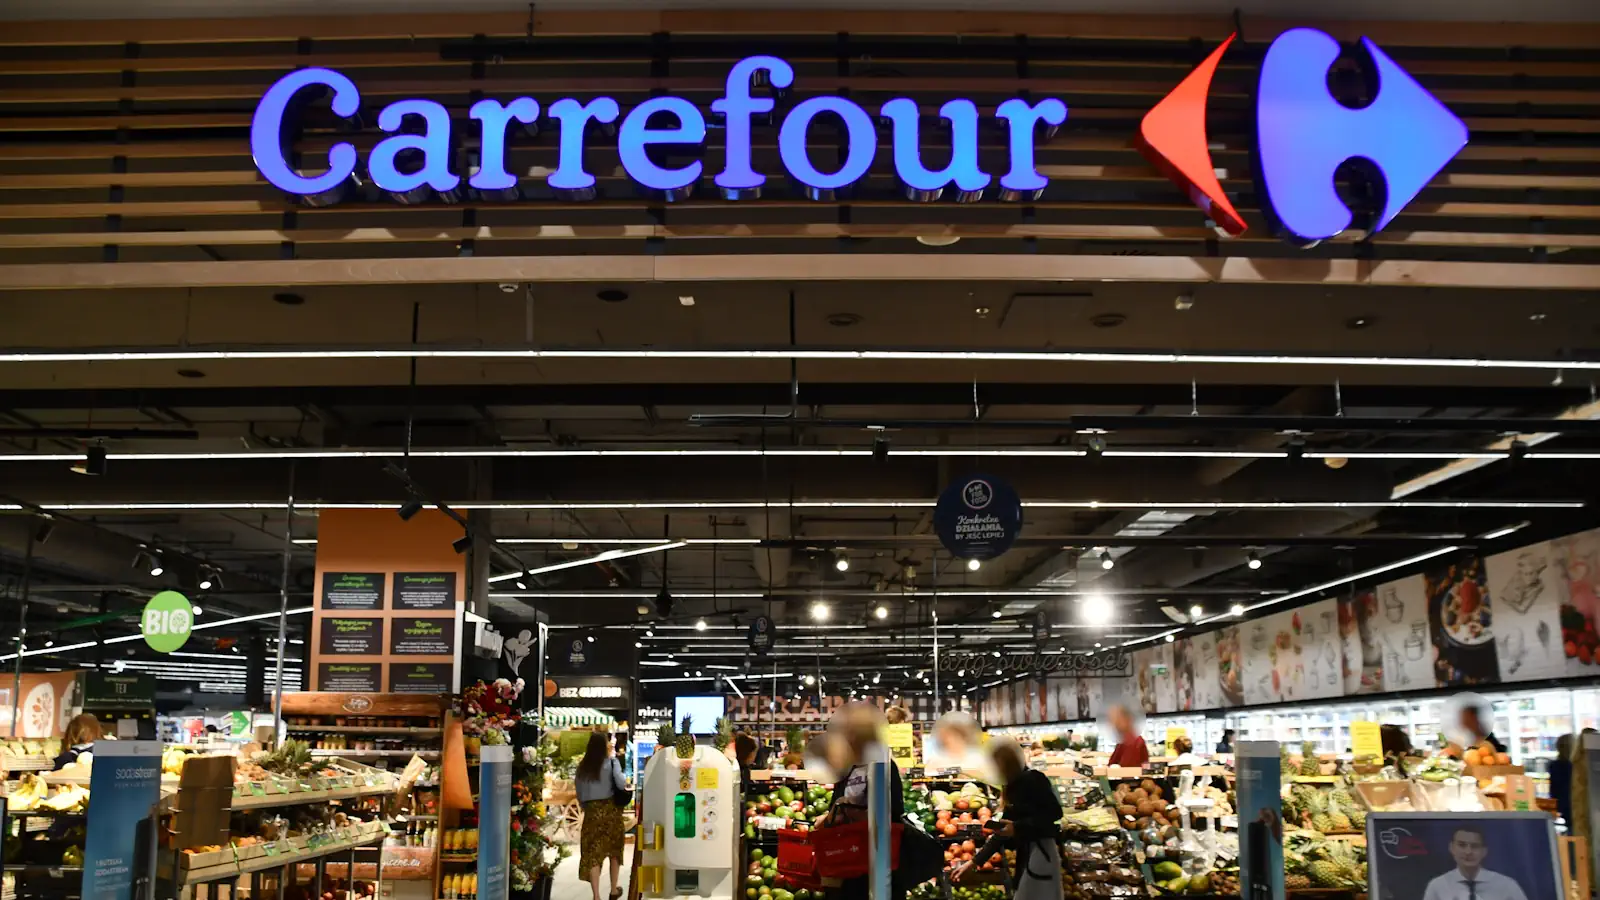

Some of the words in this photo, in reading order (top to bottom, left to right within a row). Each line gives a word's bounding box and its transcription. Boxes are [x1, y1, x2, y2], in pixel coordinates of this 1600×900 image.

[250, 55, 1068, 196] Carrefour
[957, 514, 999, 524] Konkretne
[146, 609, 190, 635] BIO
[559, 687, 578, 697] BEZ
